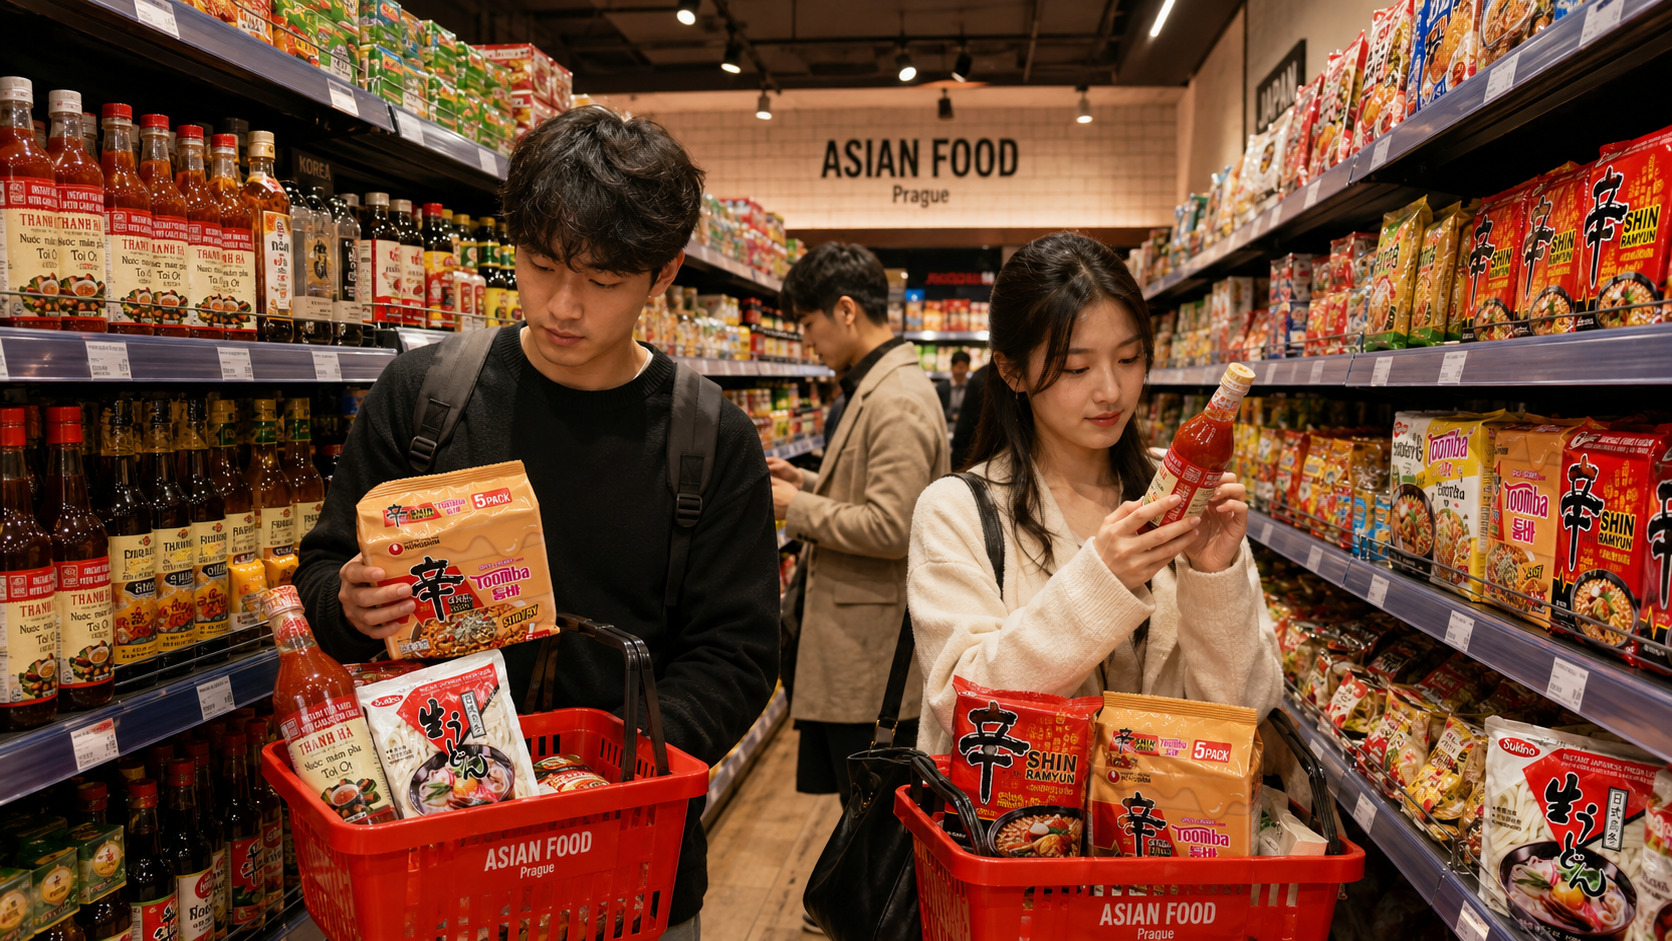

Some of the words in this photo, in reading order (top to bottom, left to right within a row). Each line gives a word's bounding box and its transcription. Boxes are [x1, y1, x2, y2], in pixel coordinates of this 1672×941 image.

[1259, 61, 1297, 129] JAPAN
[300, 155, 331, 180] KOREA
[821, 139, 919, 178] ASIAN
[932, 138, 1018, 177] FOOD
[893, 185, 949, 208] Prague
[1624, 206, 1660, 233] SHIN
[1551, 230, 1576, 254] SHIN
[1621, 230, 1656, 247] RAMYUN
[1491, 248, 1513, 268] SHIN
[1504, 482, 1548, 518] Toomba
[1601, 511, 1635, 536] SHIN
[1598, 531, 1632, 550] RAMYUN
[469, 566, 531, 590] Toomba
[298, 731, 335, 756] THANH
[1503, 738, 1536, 757] Sukino
[1027, 750, 1077, 772] SHIN
[1025, 769, 1076, 784] RAMYUN
[1171, 824, 1230, 848] Toomba
[484, 840, 541, 872] ASIAN
[546, 831, 592, 860] FOOD
[520, 864, 555, 879] Prague
[1099, 903, 1160, 926] ASIAN
[1166, 902, 1216, 925] FOOD
[1137, 927, 1175, 941] Prague
